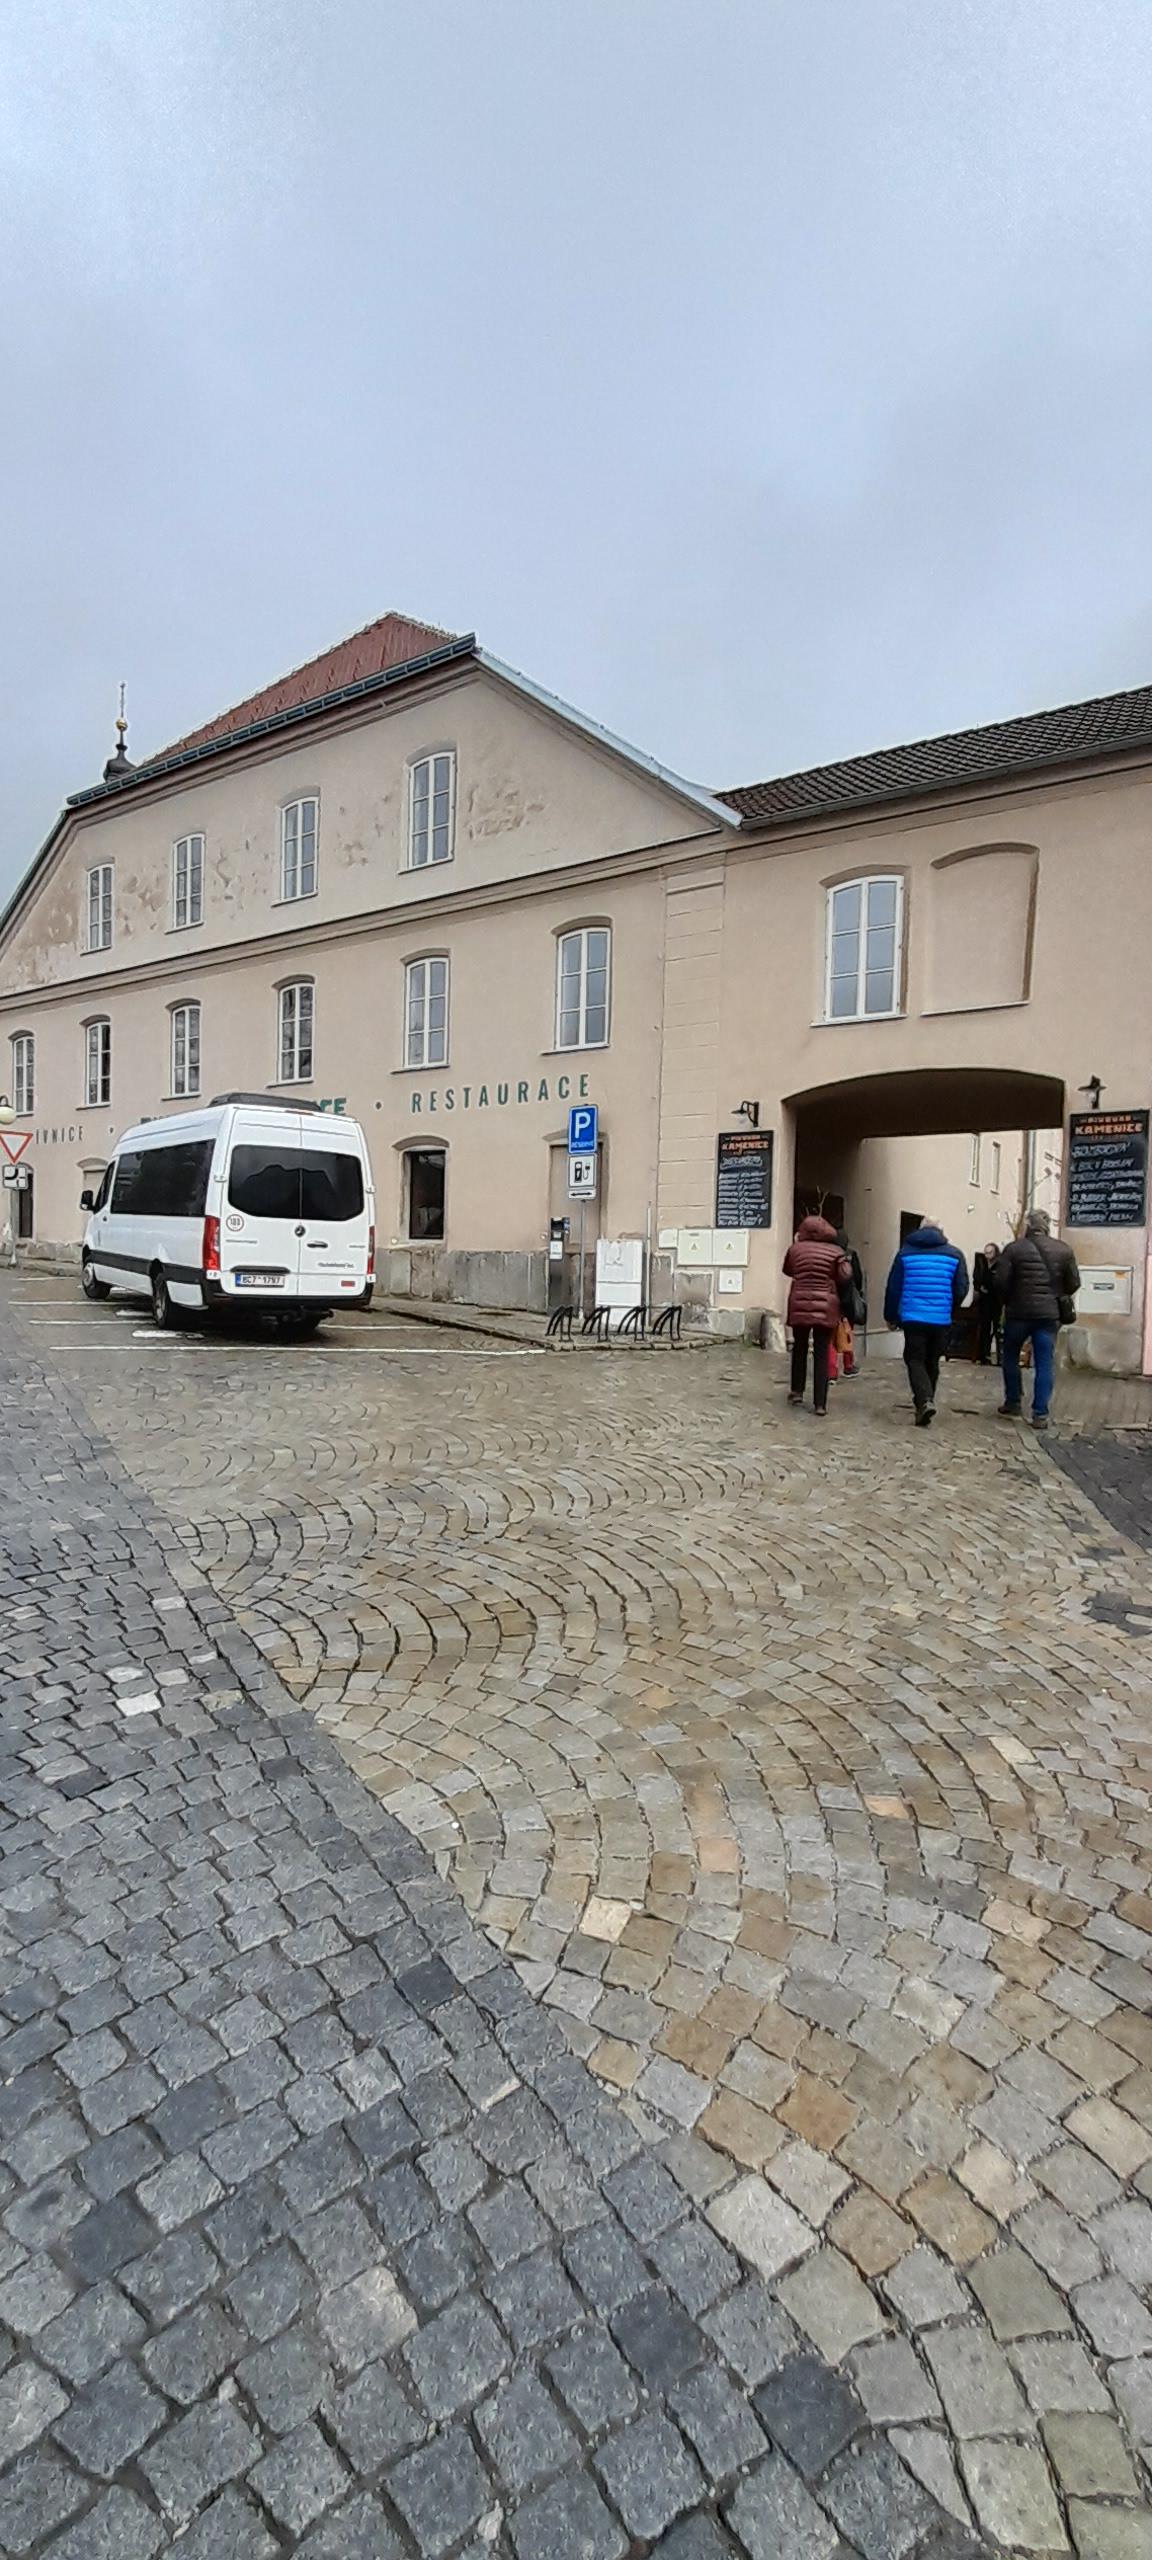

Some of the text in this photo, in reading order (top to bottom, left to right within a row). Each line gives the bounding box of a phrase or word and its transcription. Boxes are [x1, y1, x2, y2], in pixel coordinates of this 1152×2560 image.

[412, 1074, 589, 1114] RESTAURACE
[35, 1125, 84, 1145] IVNICE
[574, 1111, 591, 1138] P
[1075, 1123, 1143, 1134] KAMENICE
